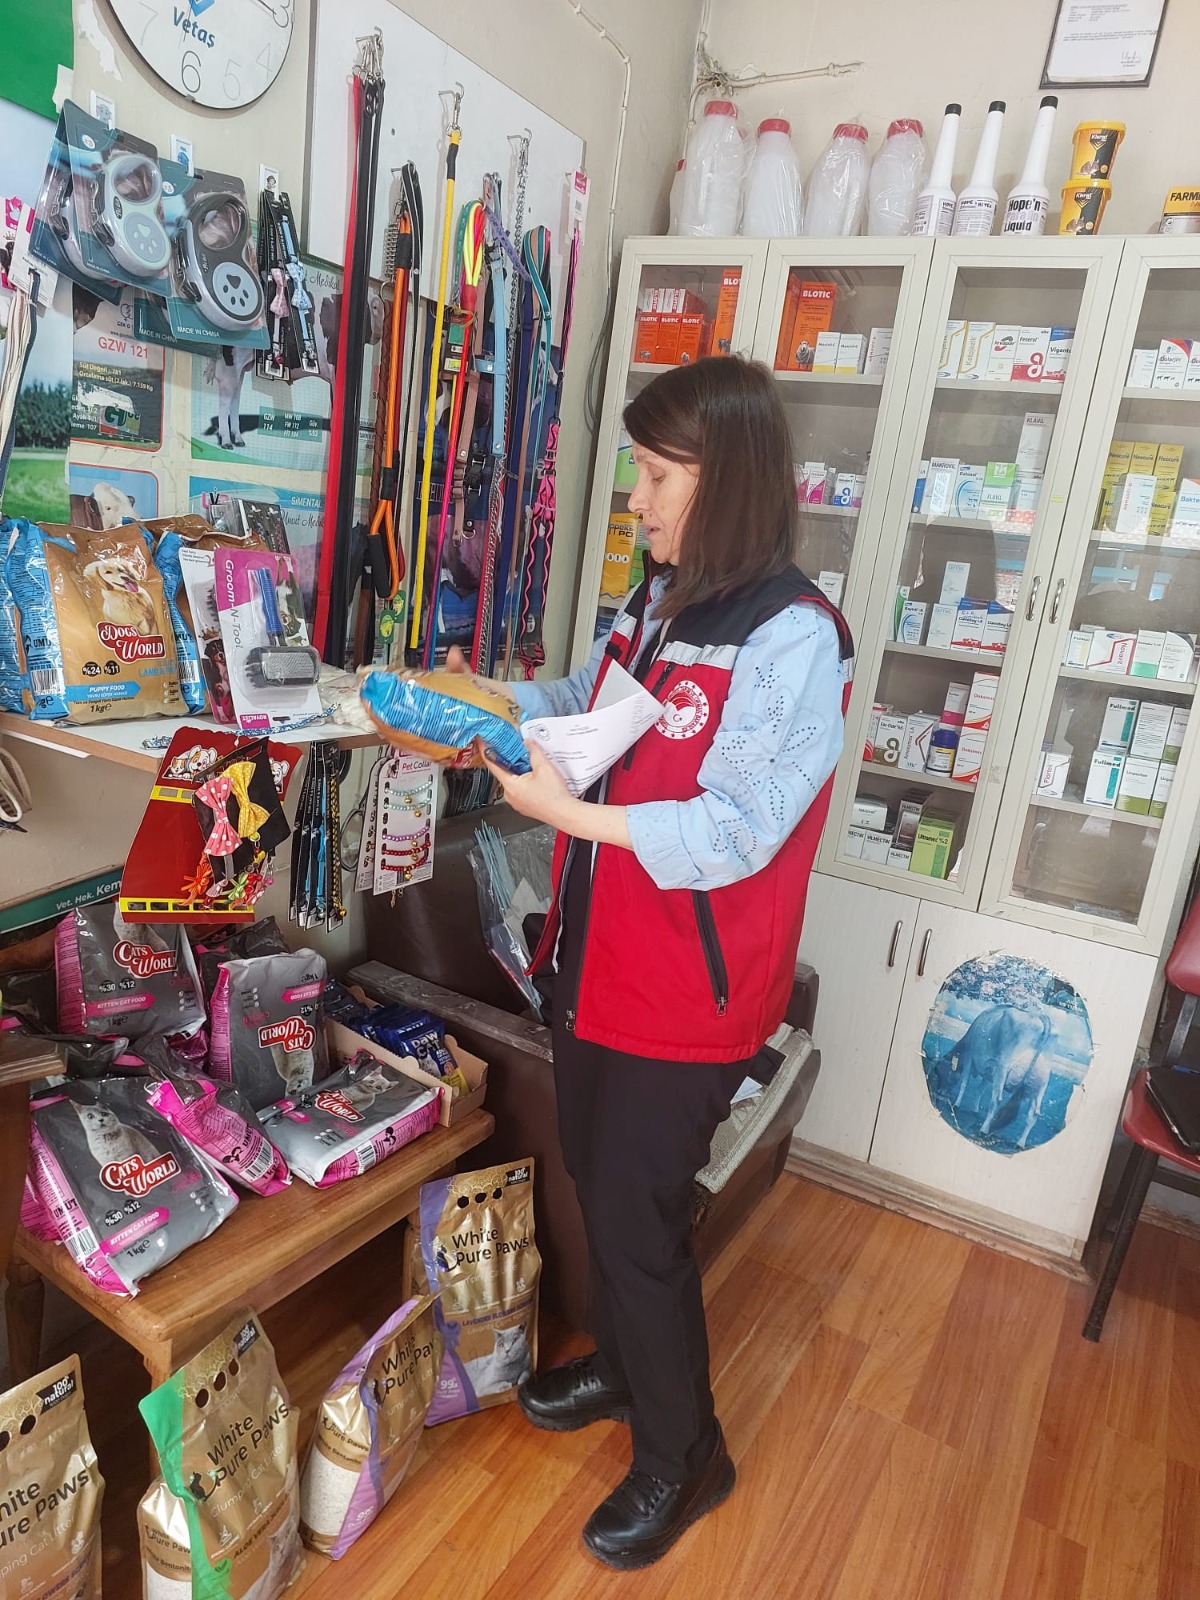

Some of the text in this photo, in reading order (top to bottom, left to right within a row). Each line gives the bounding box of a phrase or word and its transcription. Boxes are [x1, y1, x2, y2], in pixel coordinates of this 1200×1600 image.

[181, 50, 202, 93] 6
[255, 42, 273, 80] 4
[223, 59, 242, 101] 5
[1004, 220, 1032, 232] Liquid
[803, 290, 832, 298] BLOTIC
[139, 328, 154, 338] MADE
[177, 326, 193, 335] MADE
[202, 329, 220, 338] CHINA
[98, 336, 127, 354] GZW
[130, 345, 148, 359] 121
[225, 559, 244, 649] Groom-N-Tool
[34, 637, 52, 648] UMU
[116, 639, 163, 659] WORLD
[175, 633, 192, 642] MUT
[83, 665, 119, 675] %24 %11
[1110, 703, 1136, 711] Fullmed
[402, 762, 413, 771] Pet
[1094, 758, 1120, 767] Fullmed
[56, 880, 121, 911] Vet. Hek. Kem
[119, 942, 148, 961] CATS
[99, 980, 135, 993] %30 %12
[131, 996, 146, 1004] FOOD
[261, 1019, 305, 1041] WORLD
[288, 1030, 313, 1050] CATS
[319, 1095, 359, 1120] WORLD
[103, 1159, 140, 1187] CATS
[123, 1160, 178, 1195] WORLD
[104, 1200, 141, 1225] %30 %12
[110, 1211, 160, 1245] KITTEN CAT FOOD
[452, 1227, 499, 1249] White
[456, 1236, 529, 1266] Pure Paws
[382, 1336, 416, 1375] White
[386, 1339, 434, 1395] Pure Pa
[44, 1381, 74, 1405] natural
[207, 1416, 254, 1466] White
[215, 1403, 290, 1487] Pure Paws
[0, 1482, 40, 1522] hite
[0, 1469, 90, 1549] ure Paws
[153, 1532, 170, 1548] Pure
[234, 1537, 254, 1560] ALOE
[0, 1554, 28, 1579] ping
[30, 1538, 49, 1556] Cat
[160, 1558, 191, 1571] Bentonit
